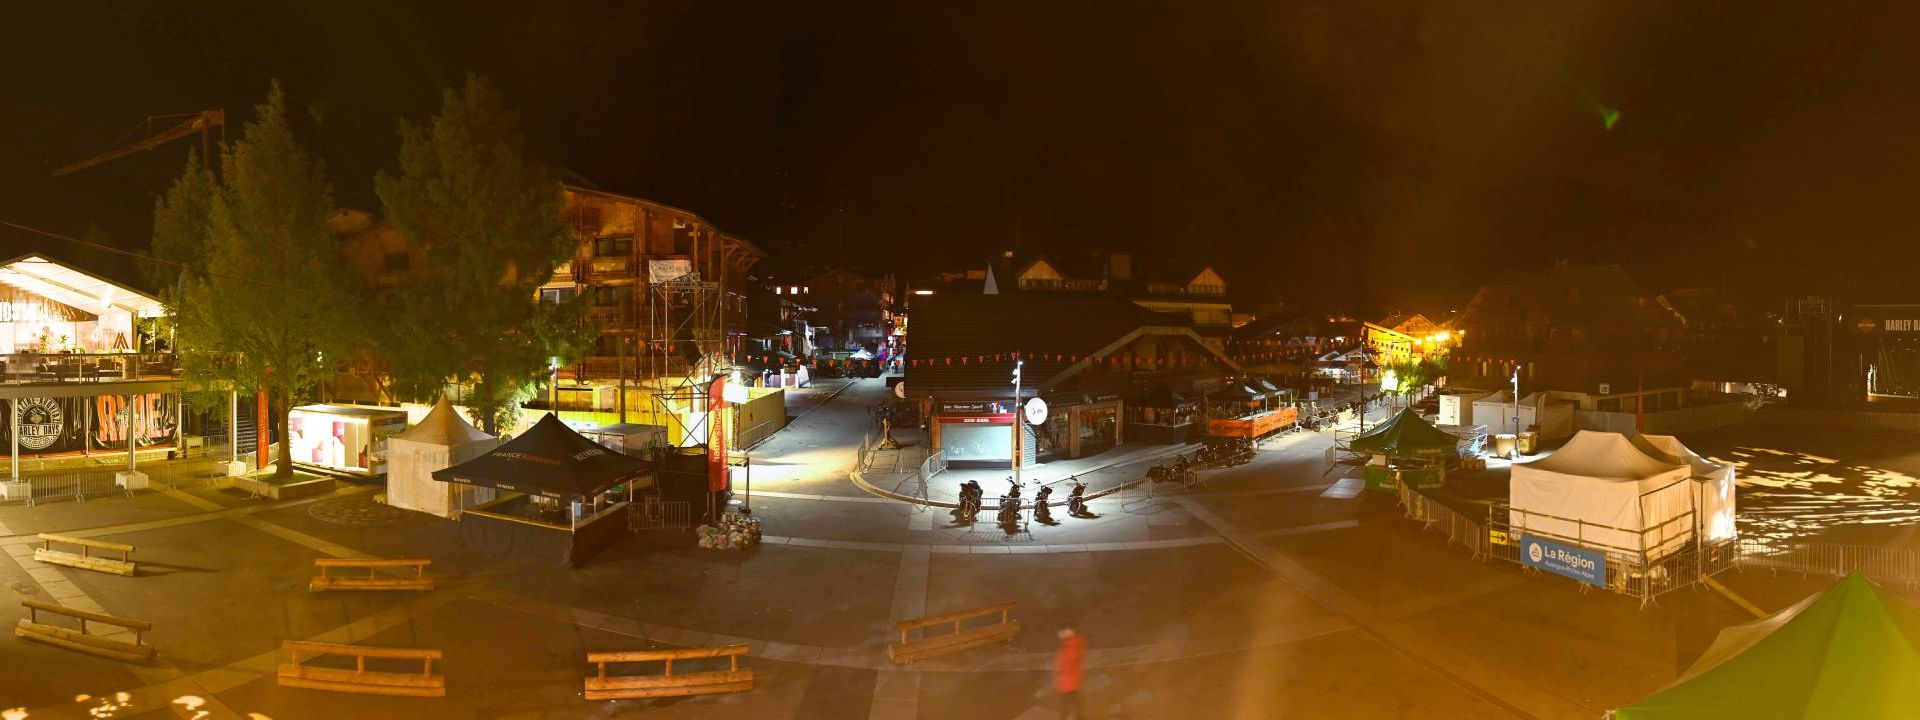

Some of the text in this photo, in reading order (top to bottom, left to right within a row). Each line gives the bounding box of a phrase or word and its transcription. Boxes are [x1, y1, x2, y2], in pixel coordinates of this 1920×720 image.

[1885, 319, 1911, 331] HARLEY
[18, 424, 60, 437] ARLEY DAYS
[1544, 546, 1595, 570] La Région
